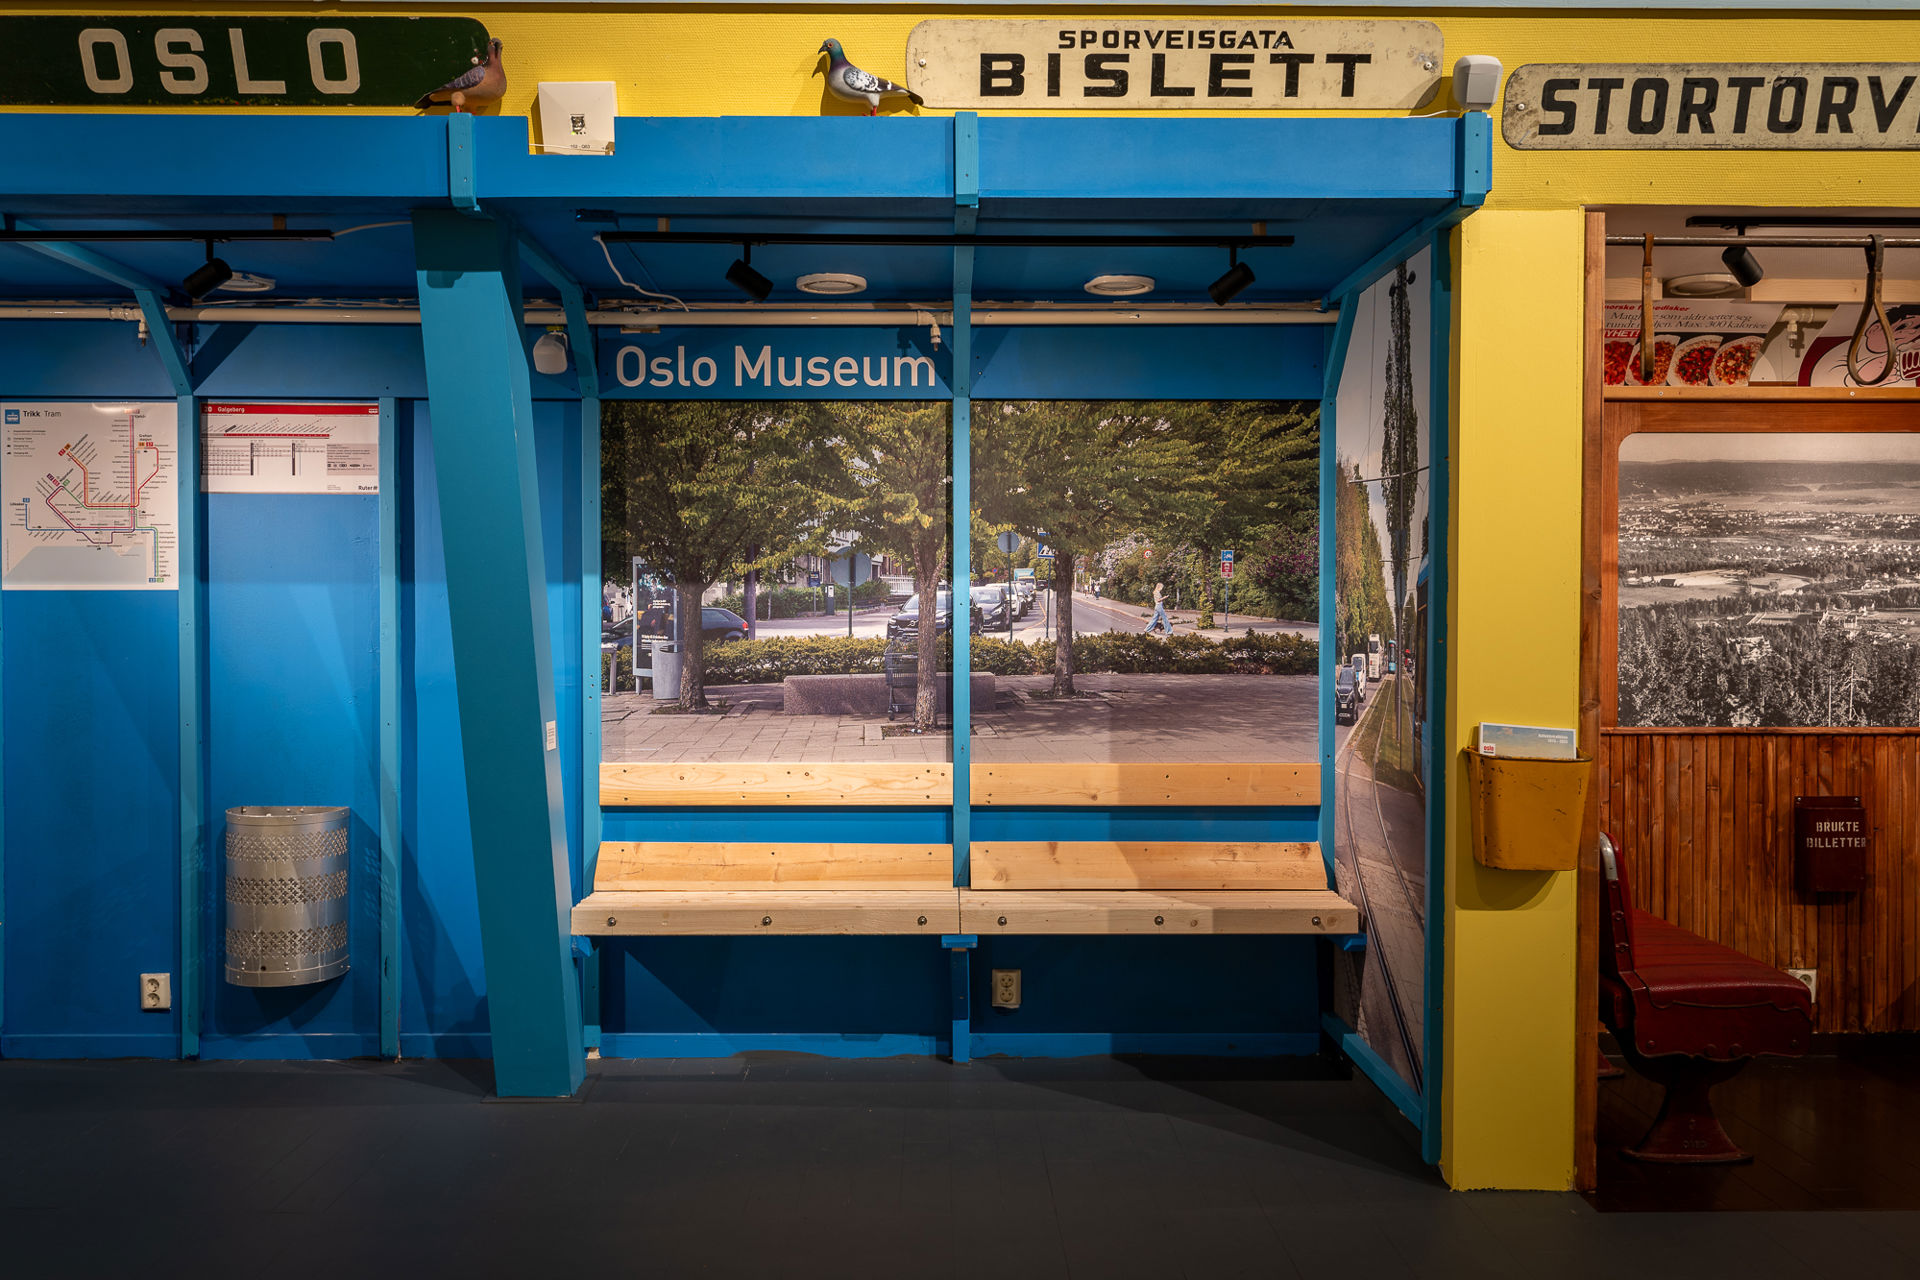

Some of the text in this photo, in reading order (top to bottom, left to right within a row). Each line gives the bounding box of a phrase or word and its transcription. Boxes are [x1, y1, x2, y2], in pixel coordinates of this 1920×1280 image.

[1058, 30, 1295, 50] SPORVEISGATA
[78, 27, 361, 94] OSLO
[979, 53, 1372, 98] BISLETT
[1538, 75, 1920, 136] STORTORV
[1605, 329, 1640, 338] YHET!
[616, 345, 936, 387] Oslo Museum
[1806, 837, 1866, 848] BILLETTER
[1816, 821, 1860, 833] BRUKTE
